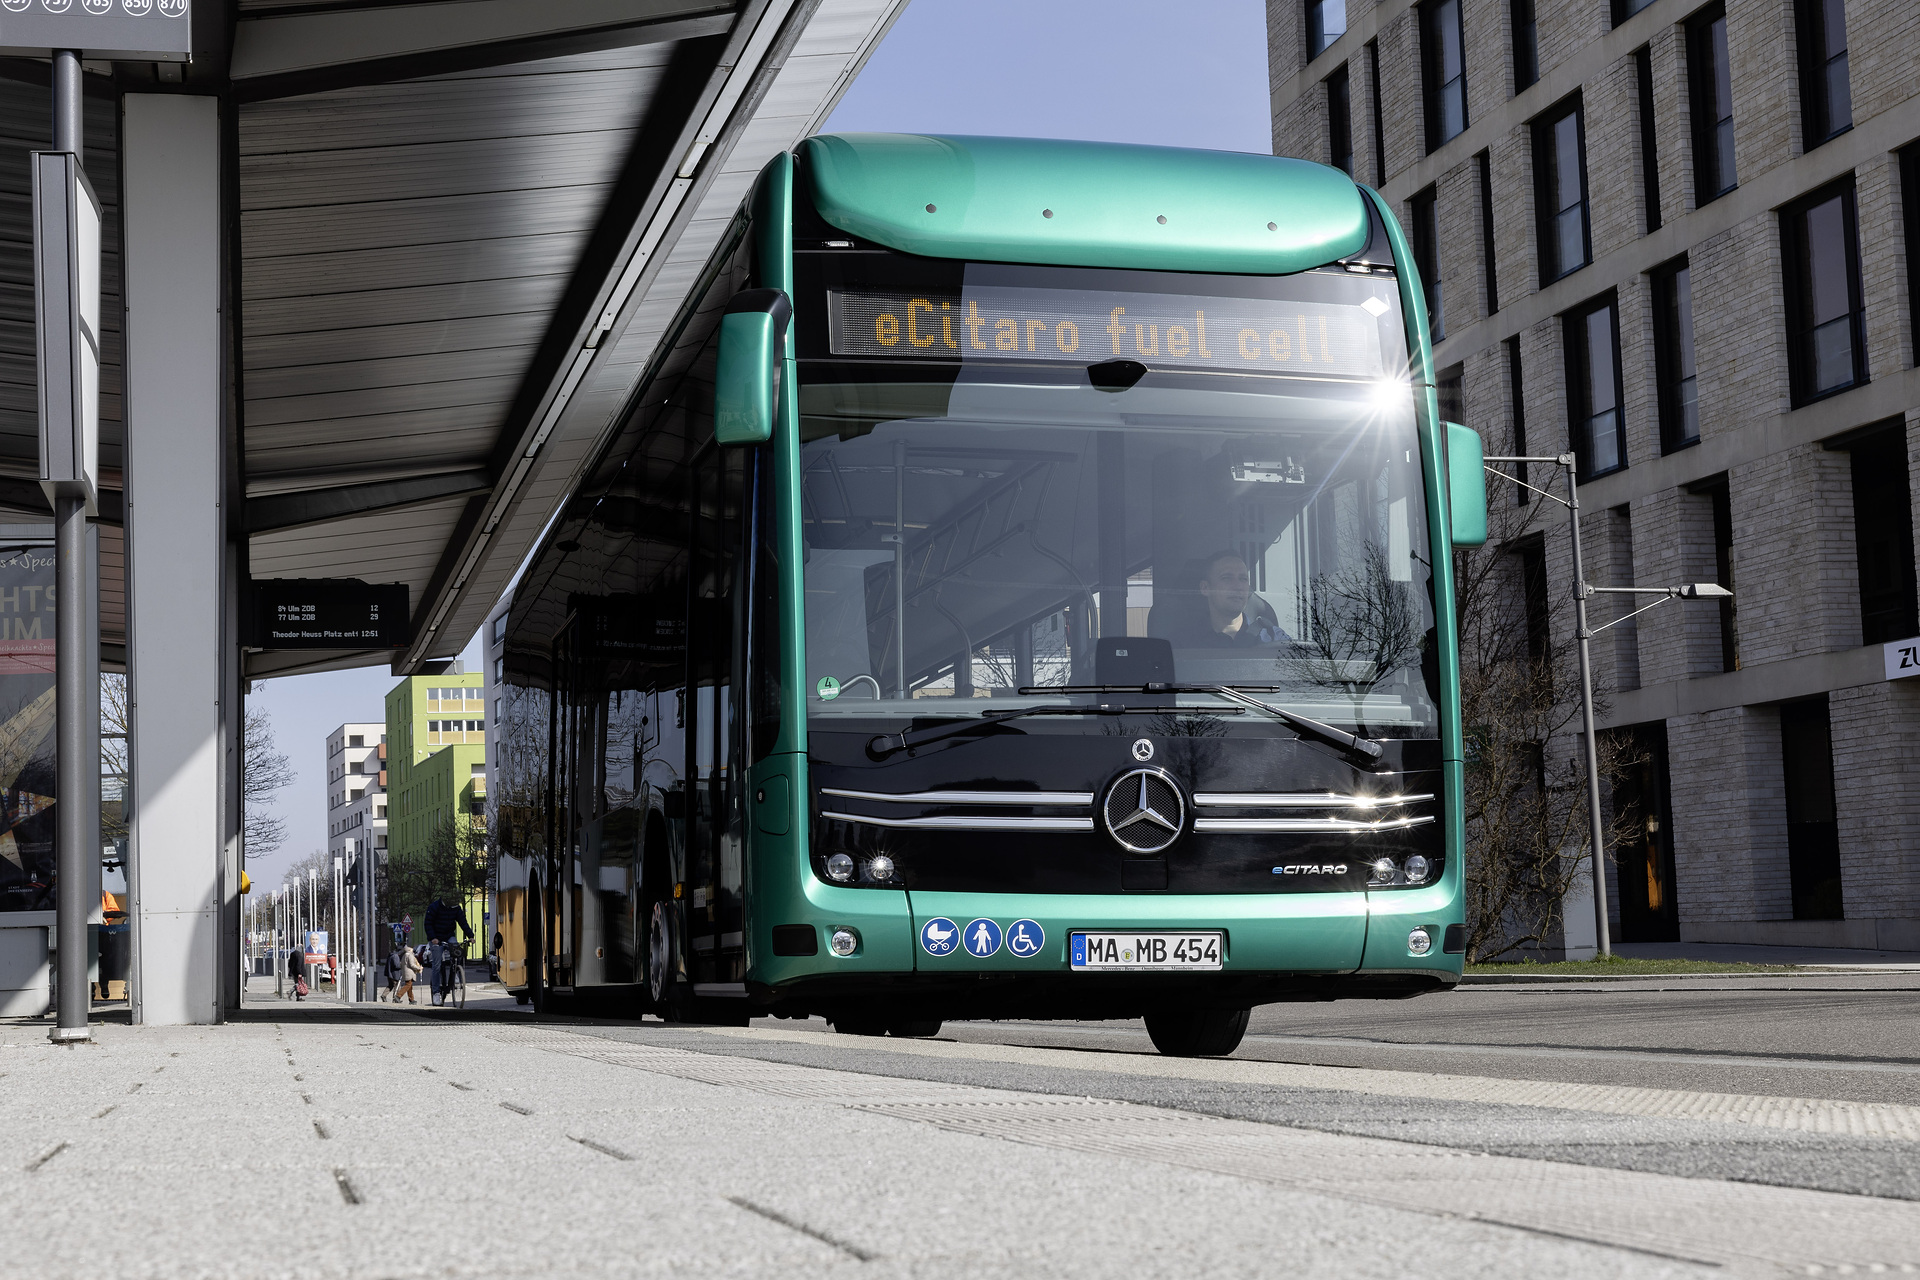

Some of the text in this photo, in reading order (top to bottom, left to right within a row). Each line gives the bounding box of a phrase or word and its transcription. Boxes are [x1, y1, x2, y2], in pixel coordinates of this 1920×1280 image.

[160, 0, 186, 10] 870
[875, 298, 1335, 363] eCitaro fuel cell
[370, 604, 379, 612] 12
[301, 613, 316, 621] ZOB
[825, 677, 832, 688] 4
[1087, 938, 1218, 963] MA MB 454
[1077, 953, 1082, 961] D
